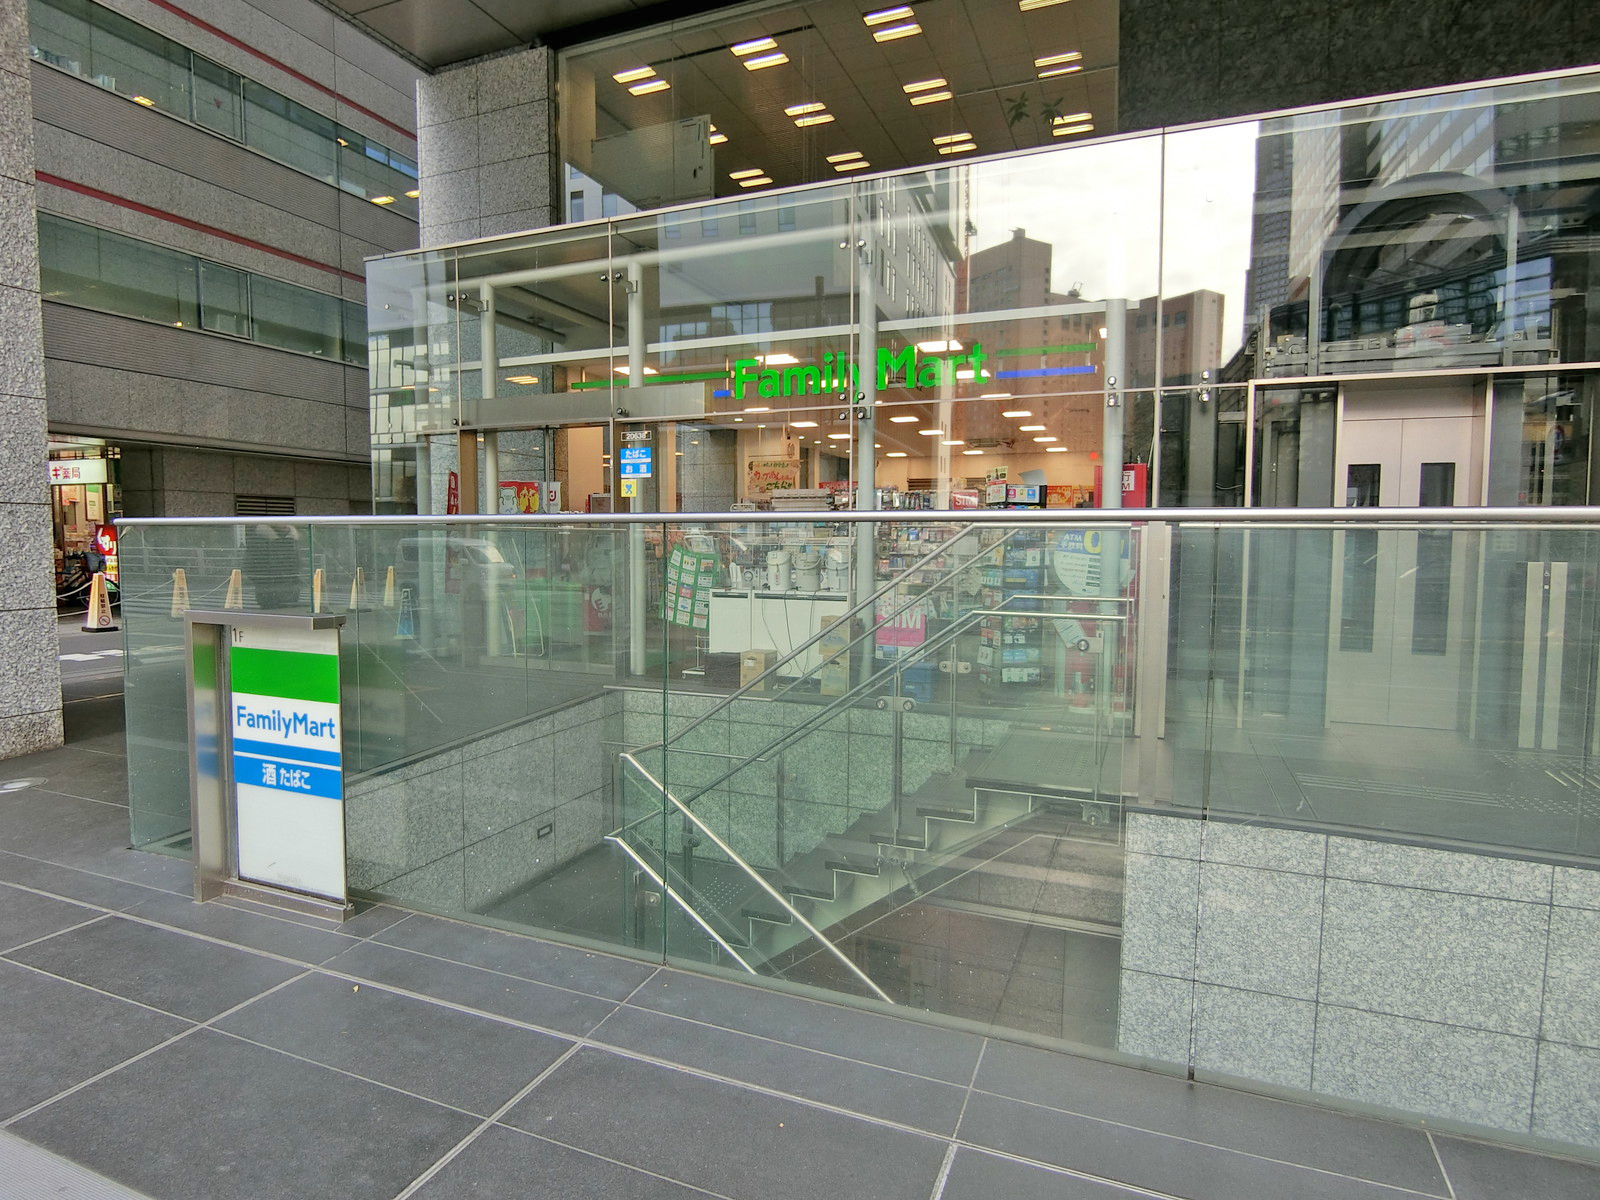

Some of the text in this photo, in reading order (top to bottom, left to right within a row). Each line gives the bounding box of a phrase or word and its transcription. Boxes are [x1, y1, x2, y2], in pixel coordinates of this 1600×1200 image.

[625, 449, 647, 459] たばこ
[51, 466, 81, 480] ギ薬局
[1063, 533, 1082, 542] ATM
[232, 628, 244, 643] 1F
[236, 705, 336, 740] FamilyMart
[262, 762, 312, 790] 酒 たばこ
